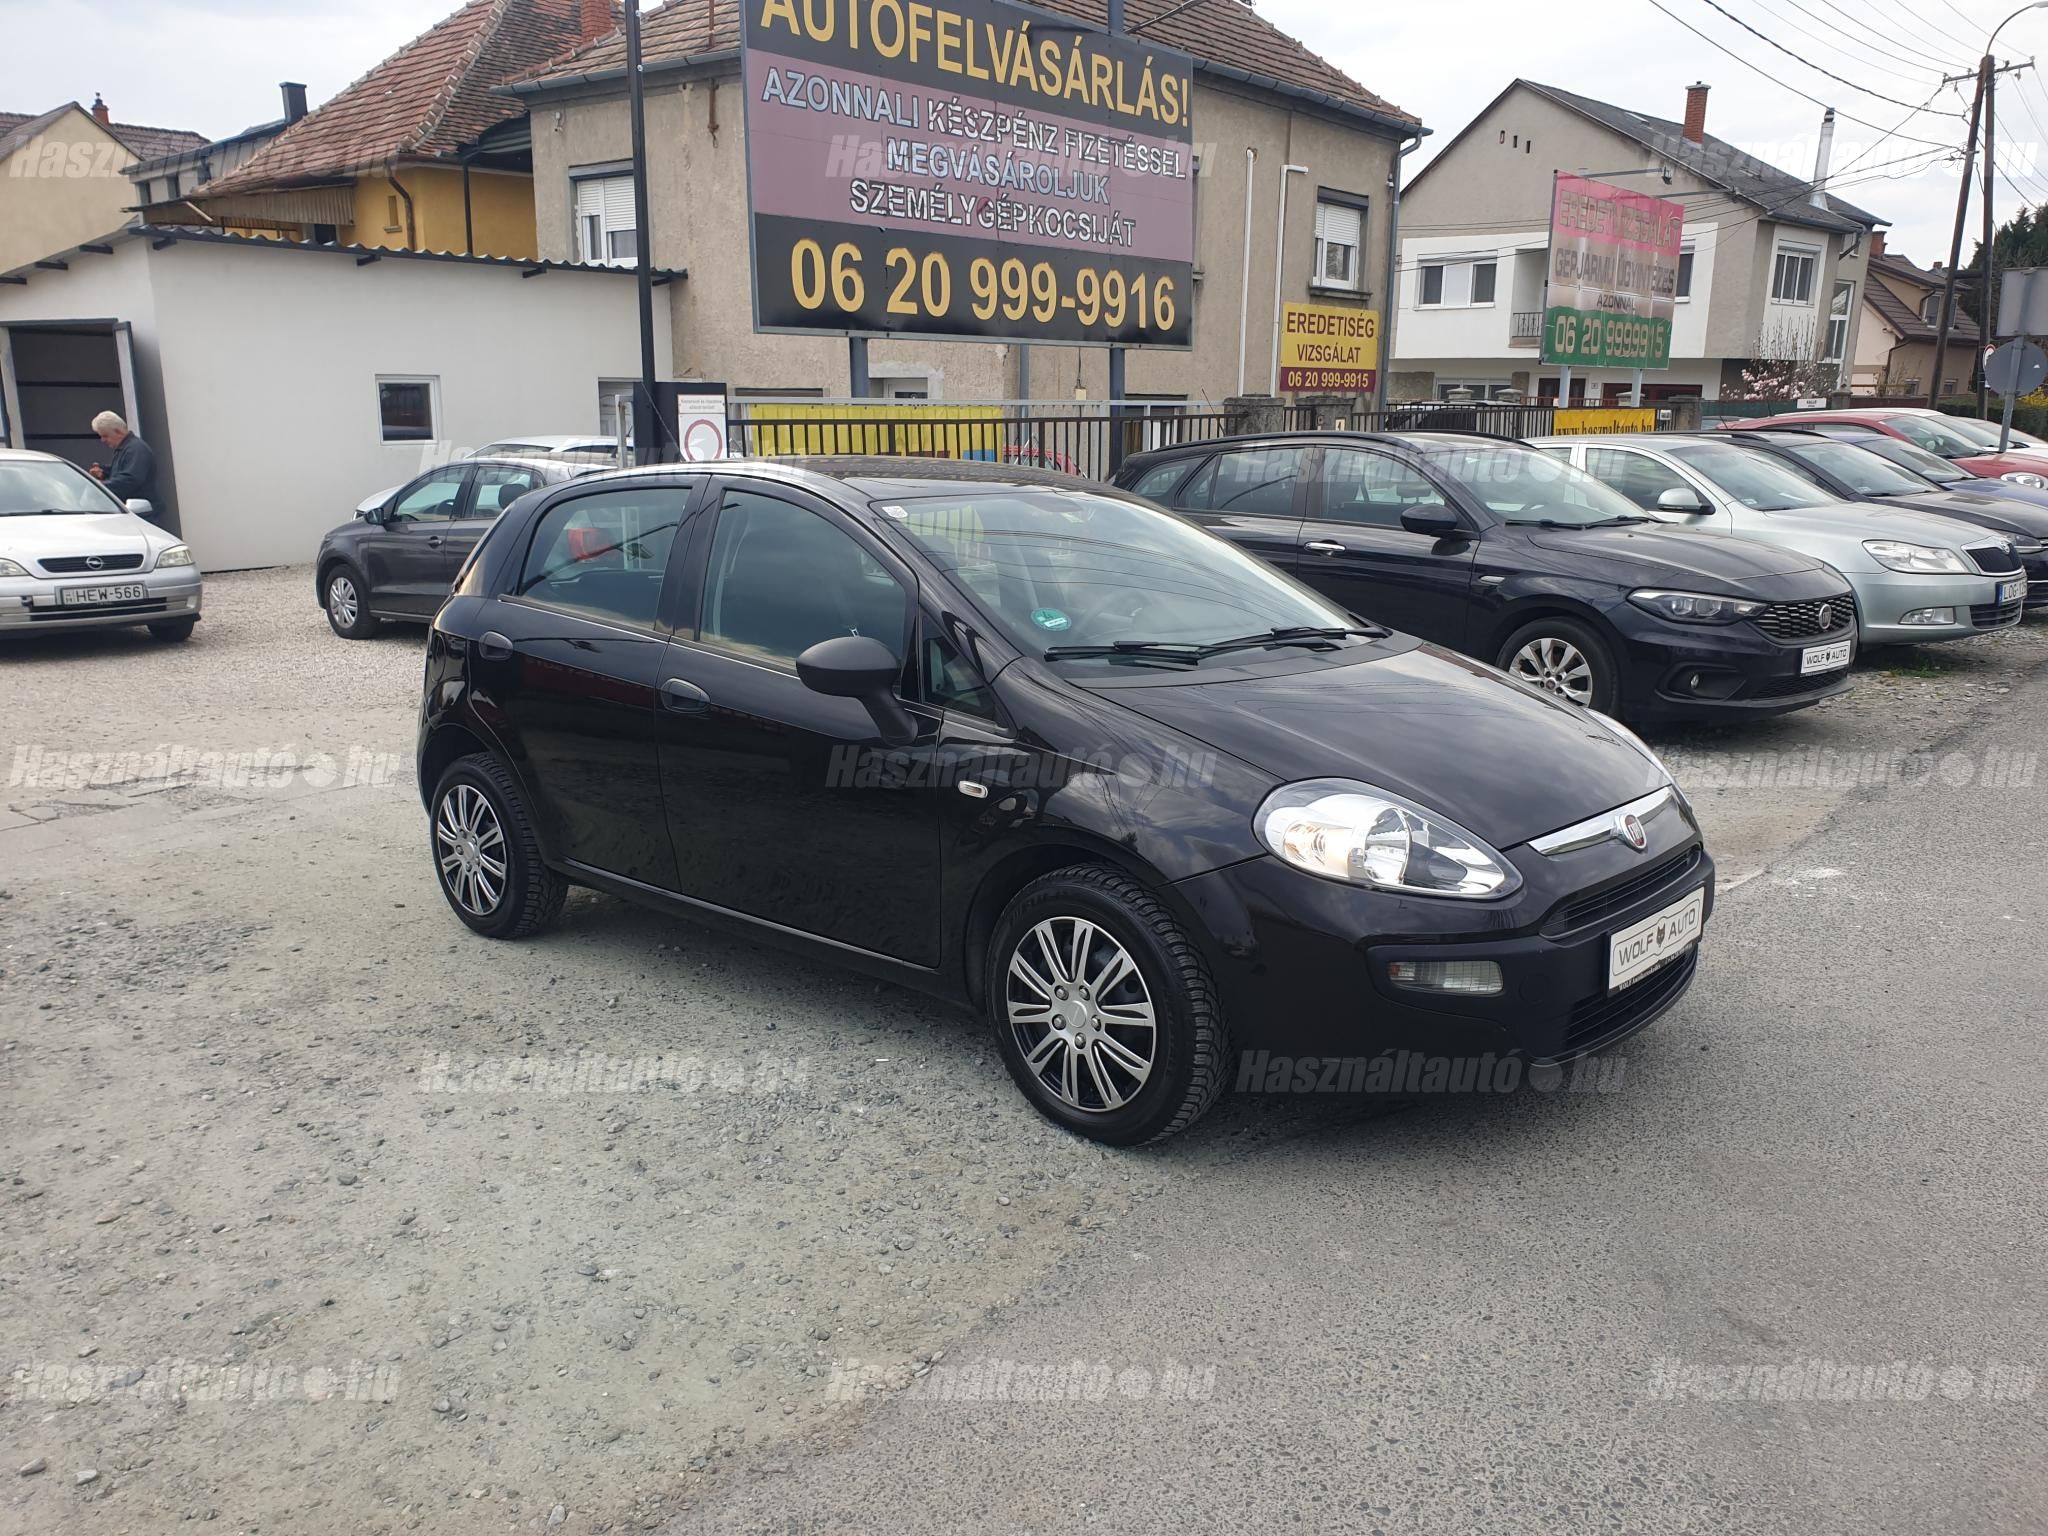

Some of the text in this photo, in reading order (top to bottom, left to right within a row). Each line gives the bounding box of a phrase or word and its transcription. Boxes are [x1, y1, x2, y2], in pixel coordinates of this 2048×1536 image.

[762, 66, 1187, 179] AZONNALI KÉSZPÉNZ FIZETÉSSEL
[886, 136, 1111, 205] MEGVÁSÁROLJUK
[791, 238, 1176, 331] 06 20 999-9916
[1287, 311, 1374, 338] EREDETISÉG
[1555, 315, 1577, 354] 06
[1580, 317, 1601, 355] 20
[1297, 342, 1361, 363] VIZSGÁLAT
[1288, 371, 1369, 388] 06 20 999-9915
[1555, 419, 1652, 435] wwwhasznaltautohu
[76, 586, 140, 602] HEW-566
[1806, 648, 1847, 665] WOLF AUTO
[1619, 932, 1654, 966] WOLF
[1668, 908, 1695, 940] AUTO
